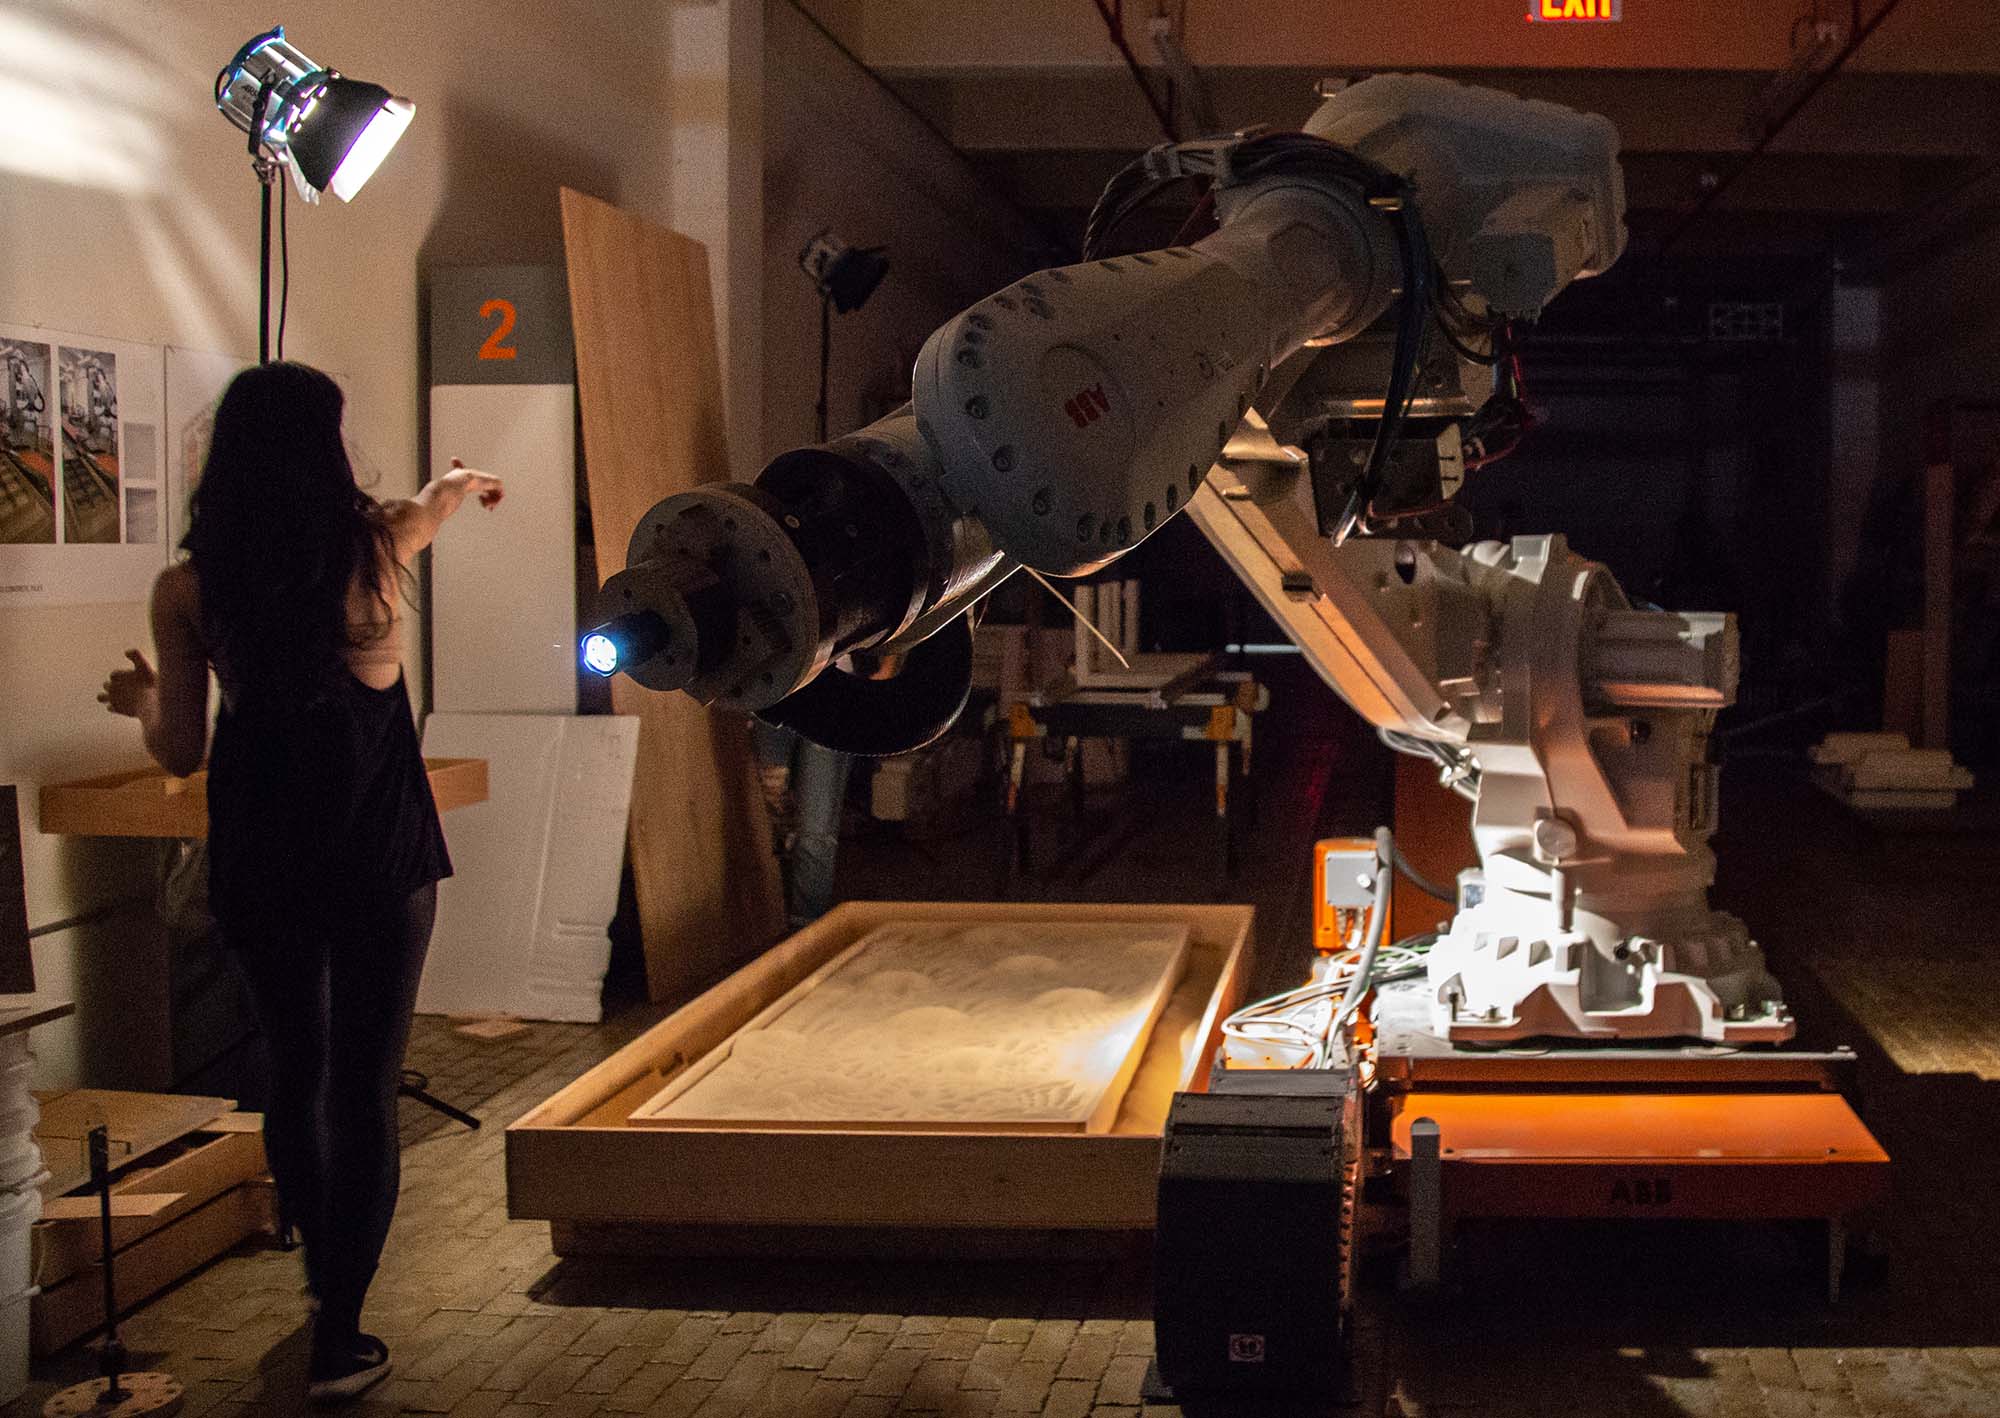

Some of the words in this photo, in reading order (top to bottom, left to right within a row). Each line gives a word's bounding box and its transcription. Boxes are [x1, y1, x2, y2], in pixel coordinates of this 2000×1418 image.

[479, 298, 517, 360] 2
[1064, 382, 1111, 428] ABB
[1610, 1178, 1672, 1204] ABB
